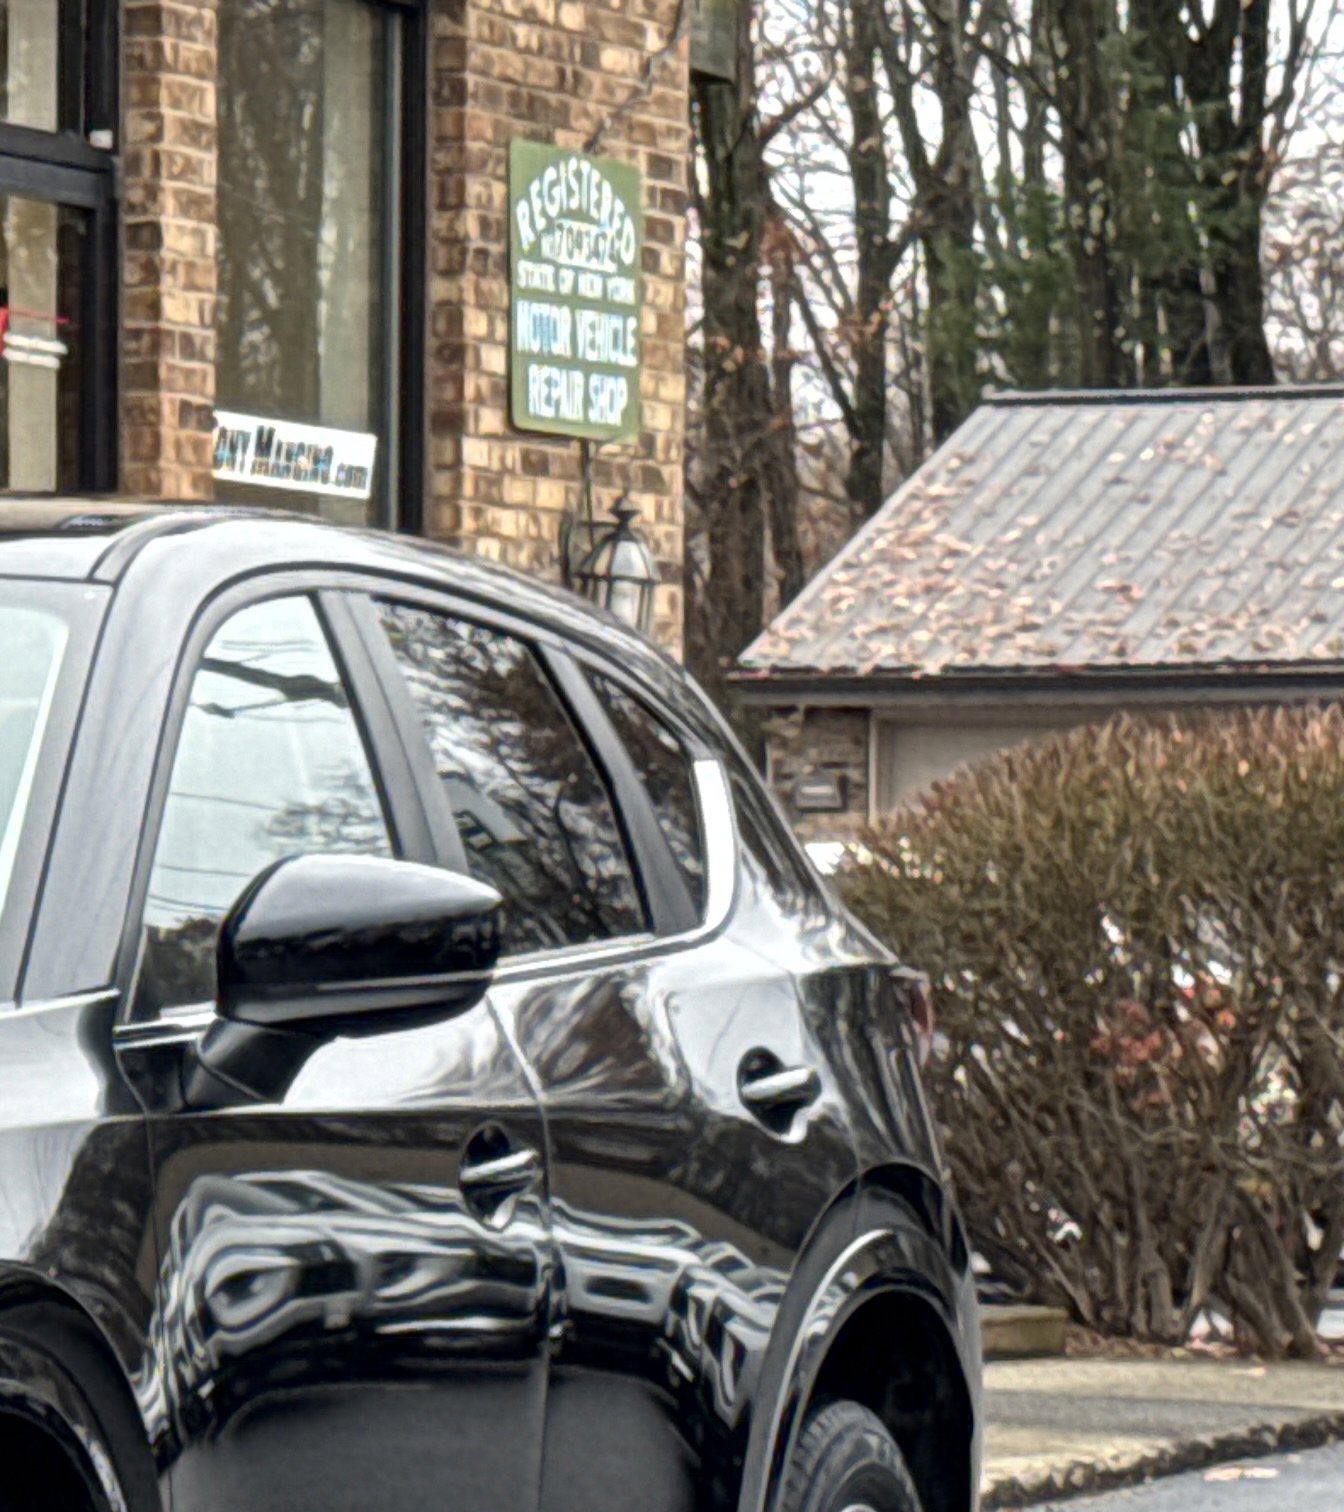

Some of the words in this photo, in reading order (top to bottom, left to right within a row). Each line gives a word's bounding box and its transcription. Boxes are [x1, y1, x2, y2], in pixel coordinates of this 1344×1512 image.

[516, 157, 635, 266] REGISTERED
[575, 309, 638, 367] VEHICLE
[528, 364, 584, 422] REPAIR
[589, 373, 628, 428] SHOP
